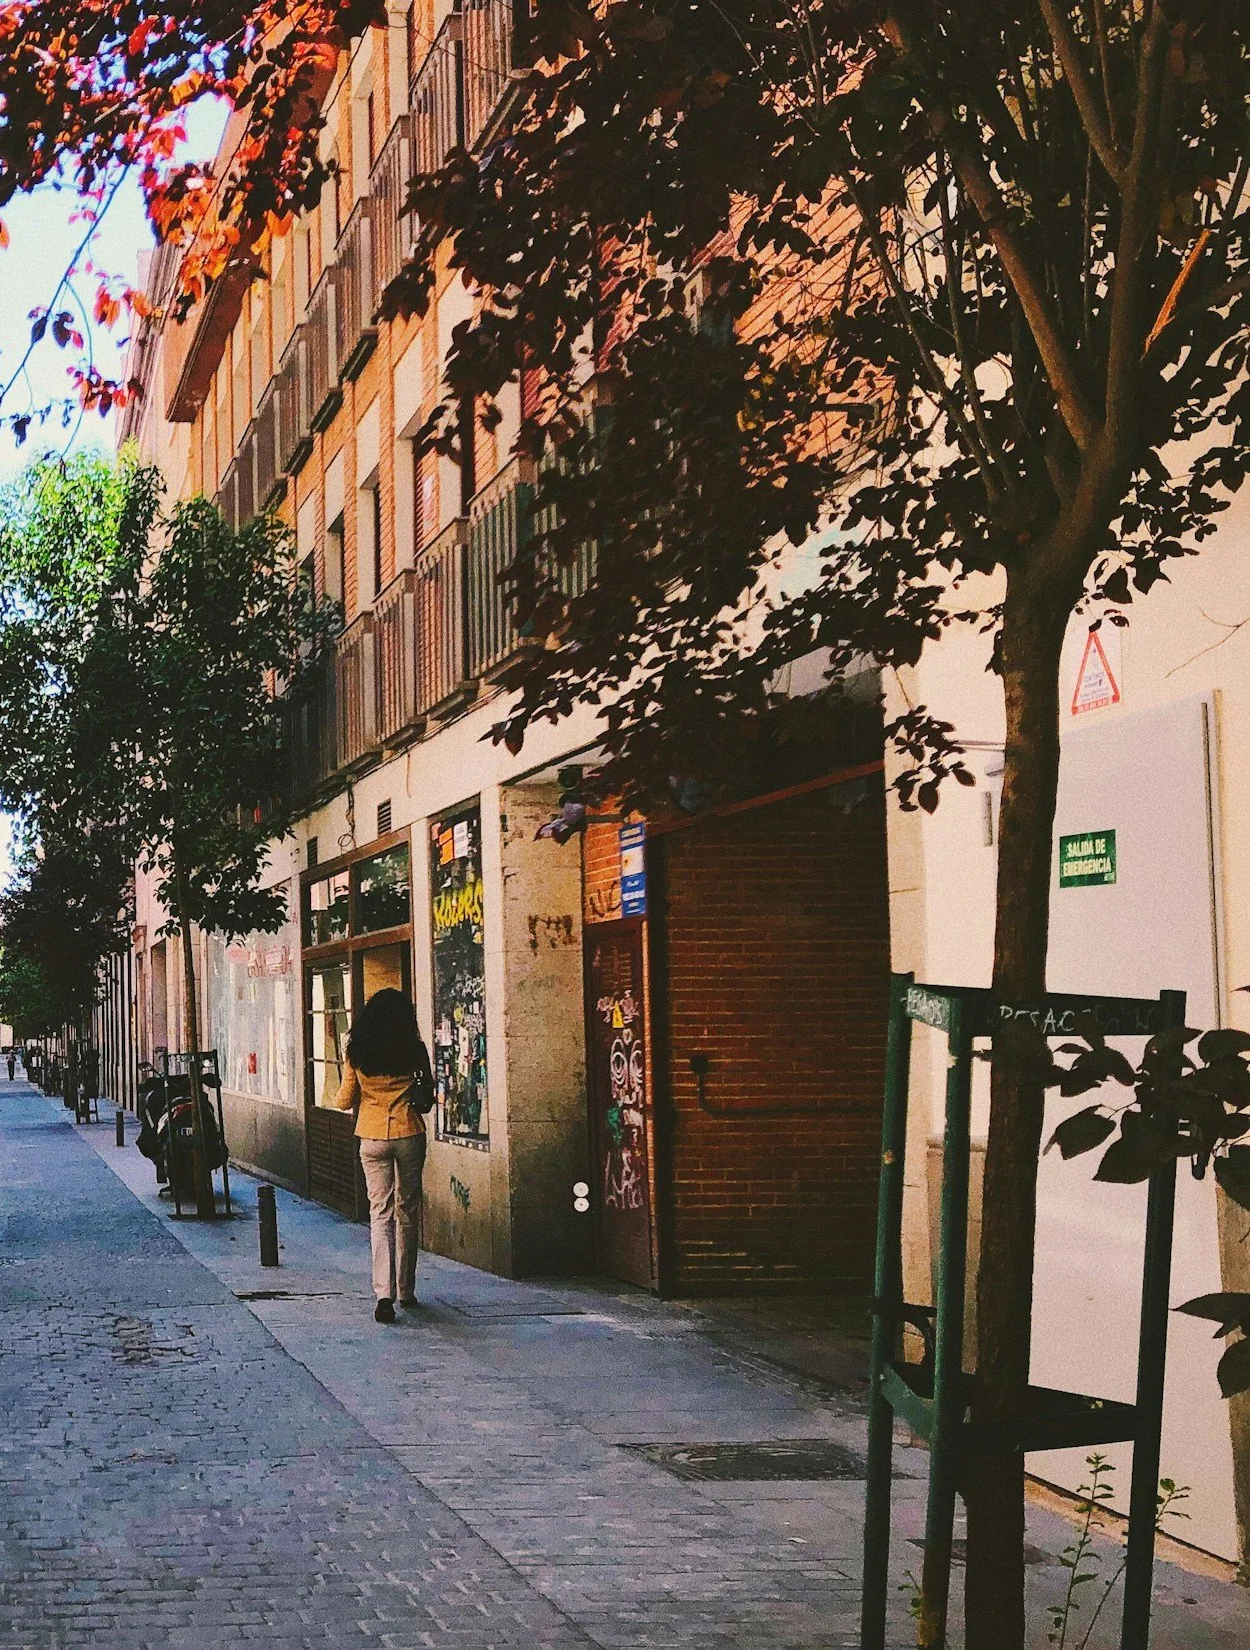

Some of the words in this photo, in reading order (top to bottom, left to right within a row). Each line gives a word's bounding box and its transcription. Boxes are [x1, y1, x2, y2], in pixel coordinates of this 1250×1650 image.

[1066, 840, 1094, 858] SALIDA
[1095, 838, 1106, 855] DE
[1062, 857, 1112, 877] EMERGENCIA
